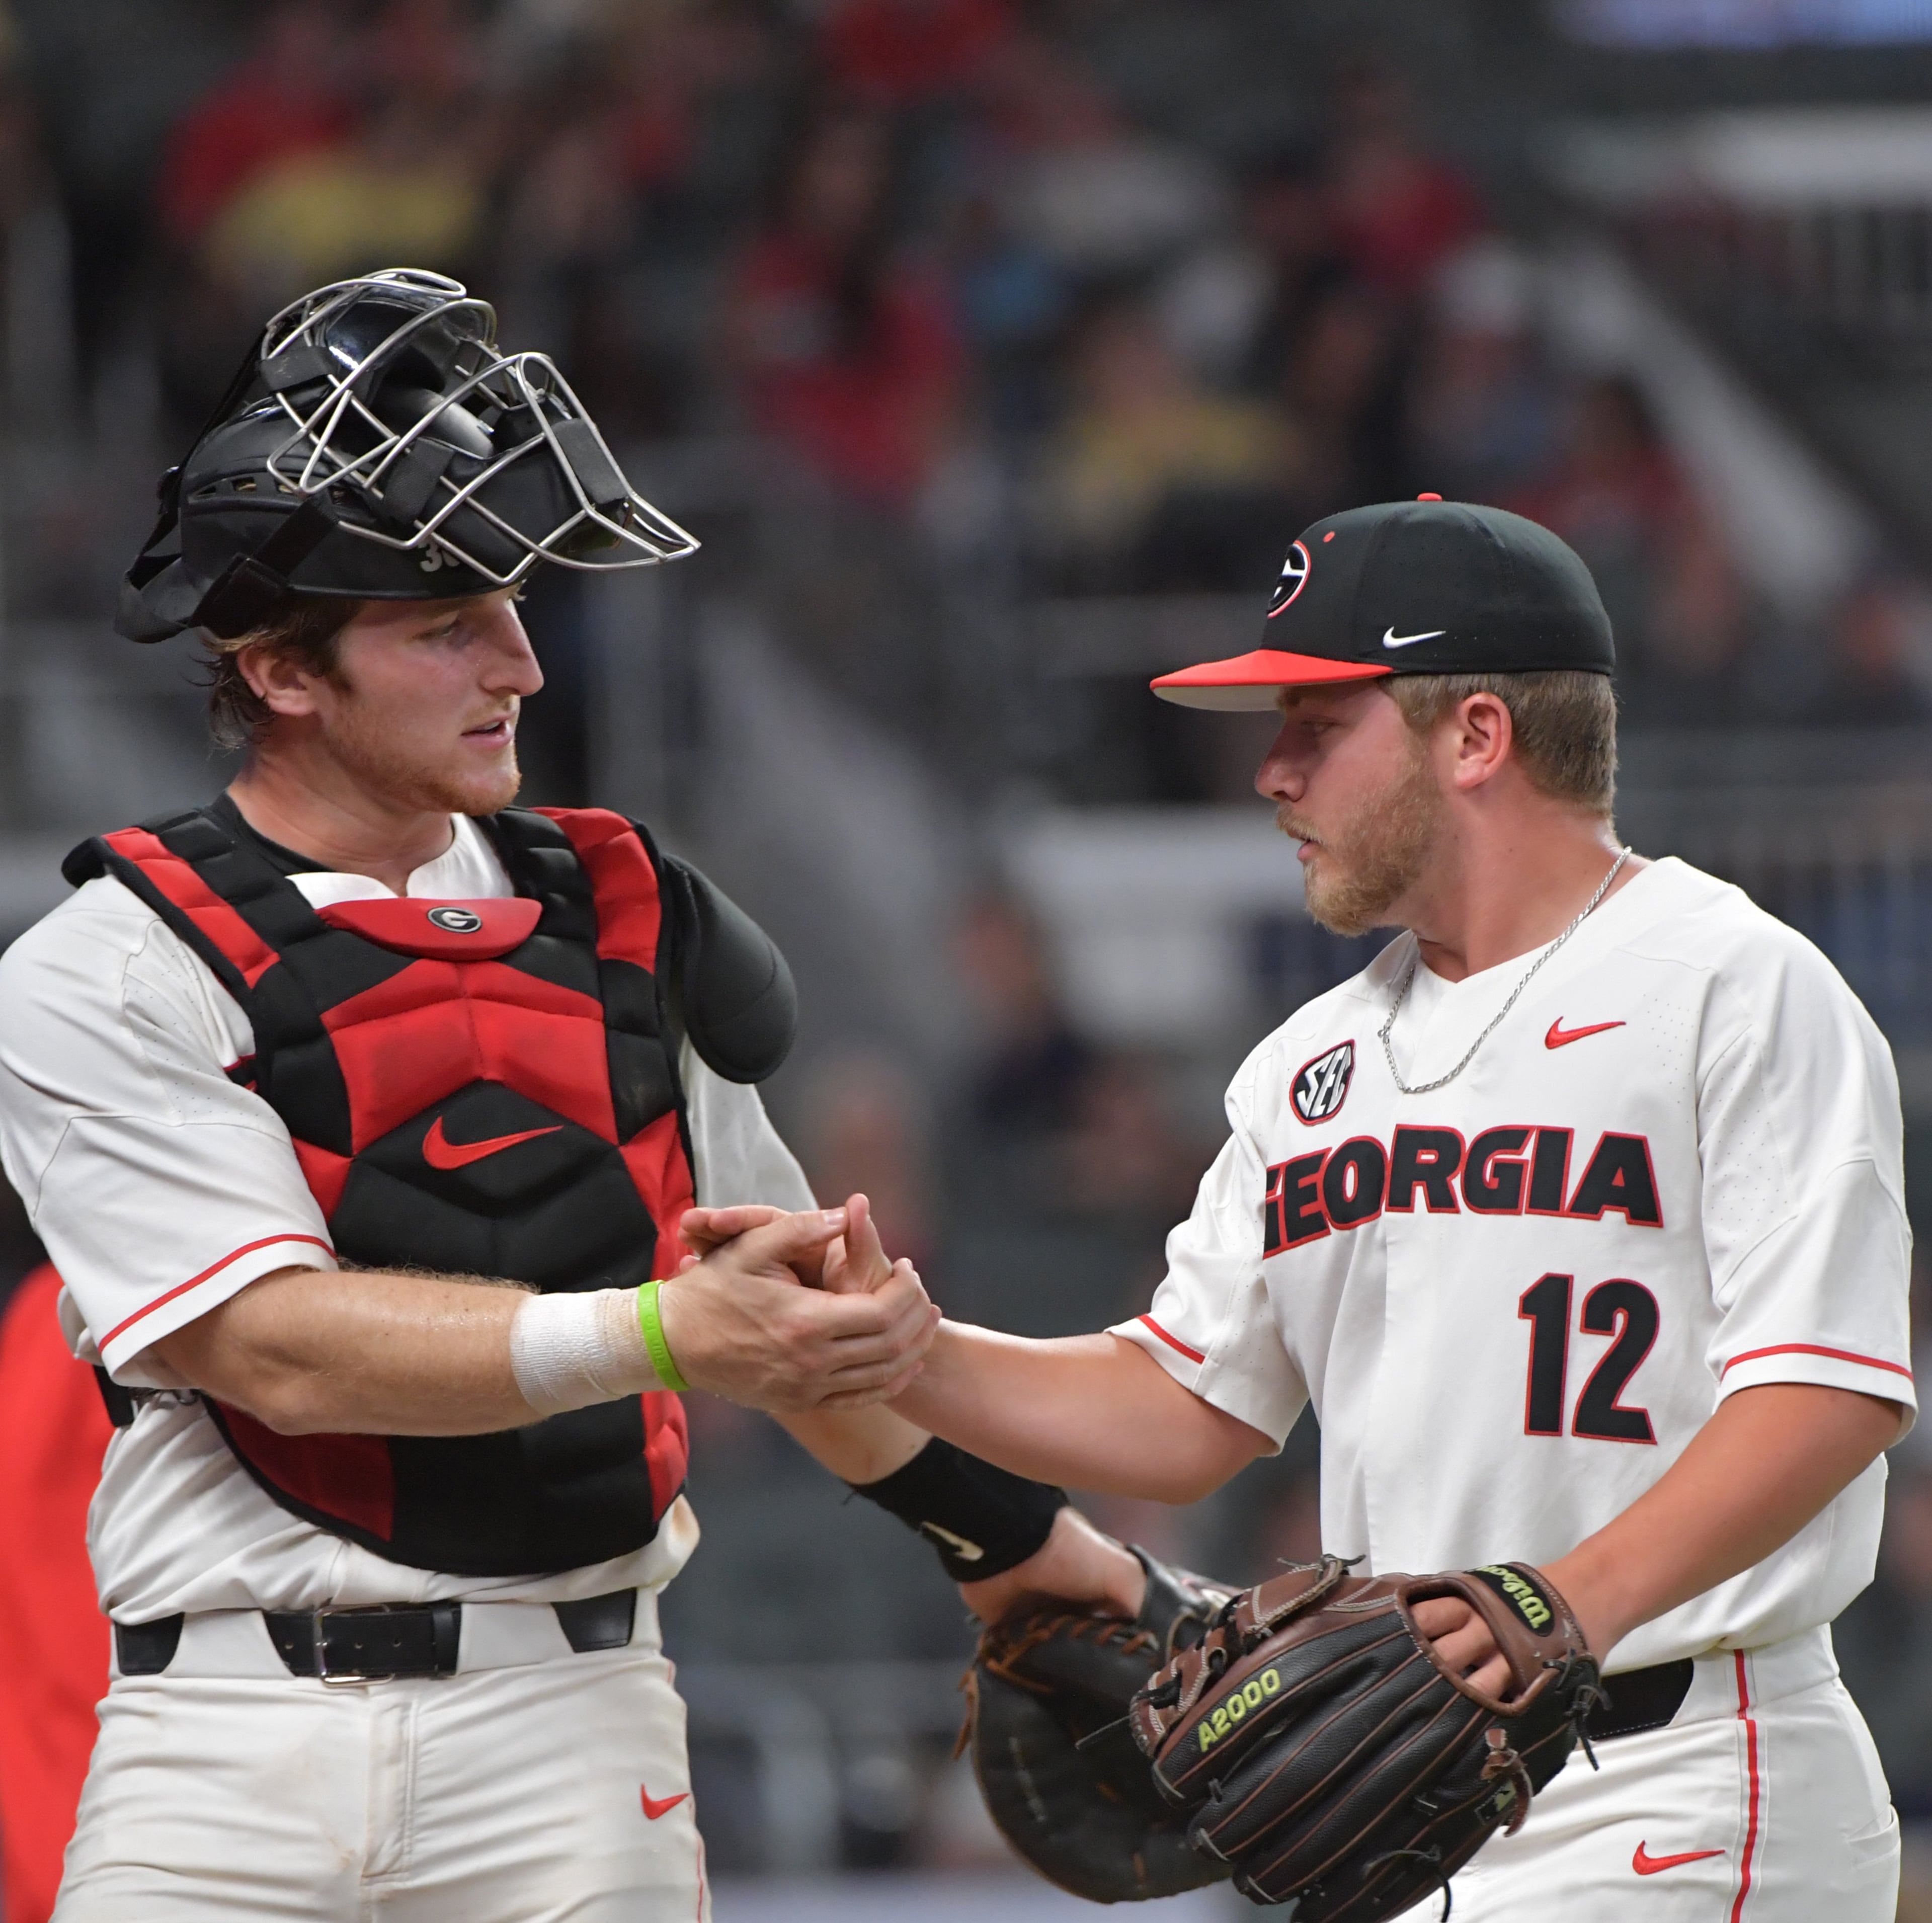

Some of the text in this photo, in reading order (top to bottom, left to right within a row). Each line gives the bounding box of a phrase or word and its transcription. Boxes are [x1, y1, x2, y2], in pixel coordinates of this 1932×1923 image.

[1297, 1045, 1352, 1118] SEC
[1518, 1272, 1660, 1445] 12
[1476, 1566, 1551, 1629] Wilson
[1198, 1668, 1281, 1752] A2000
